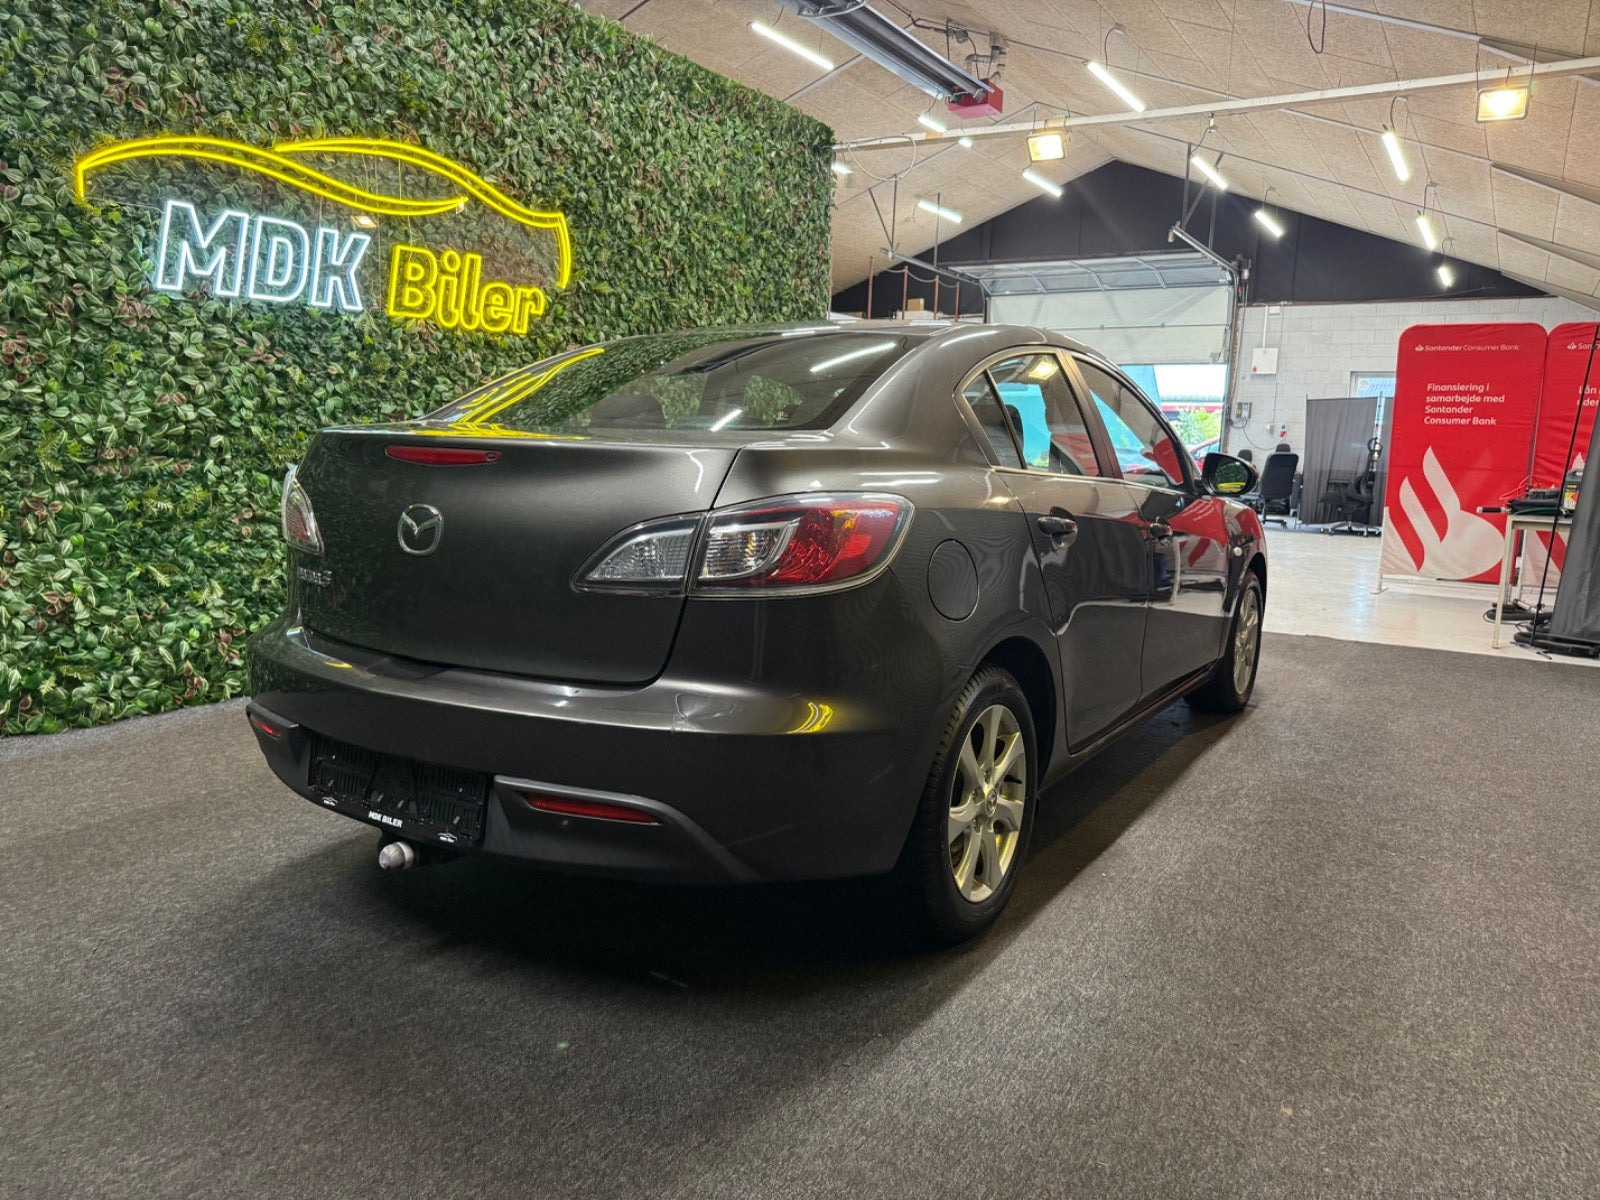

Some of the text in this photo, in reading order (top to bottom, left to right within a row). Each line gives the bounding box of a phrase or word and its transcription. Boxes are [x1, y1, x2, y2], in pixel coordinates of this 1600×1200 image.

[155, 199, 370, 313] MDK
[387, 244, 545, 335] Biler
[1427, 383, 1485, 393] Finansiering
[1425, 394, 1505, 404] samarbejde med
[1424, 405, 1474, 414] Santander
[1423, 416, 1496, 425] Consumer Bank
